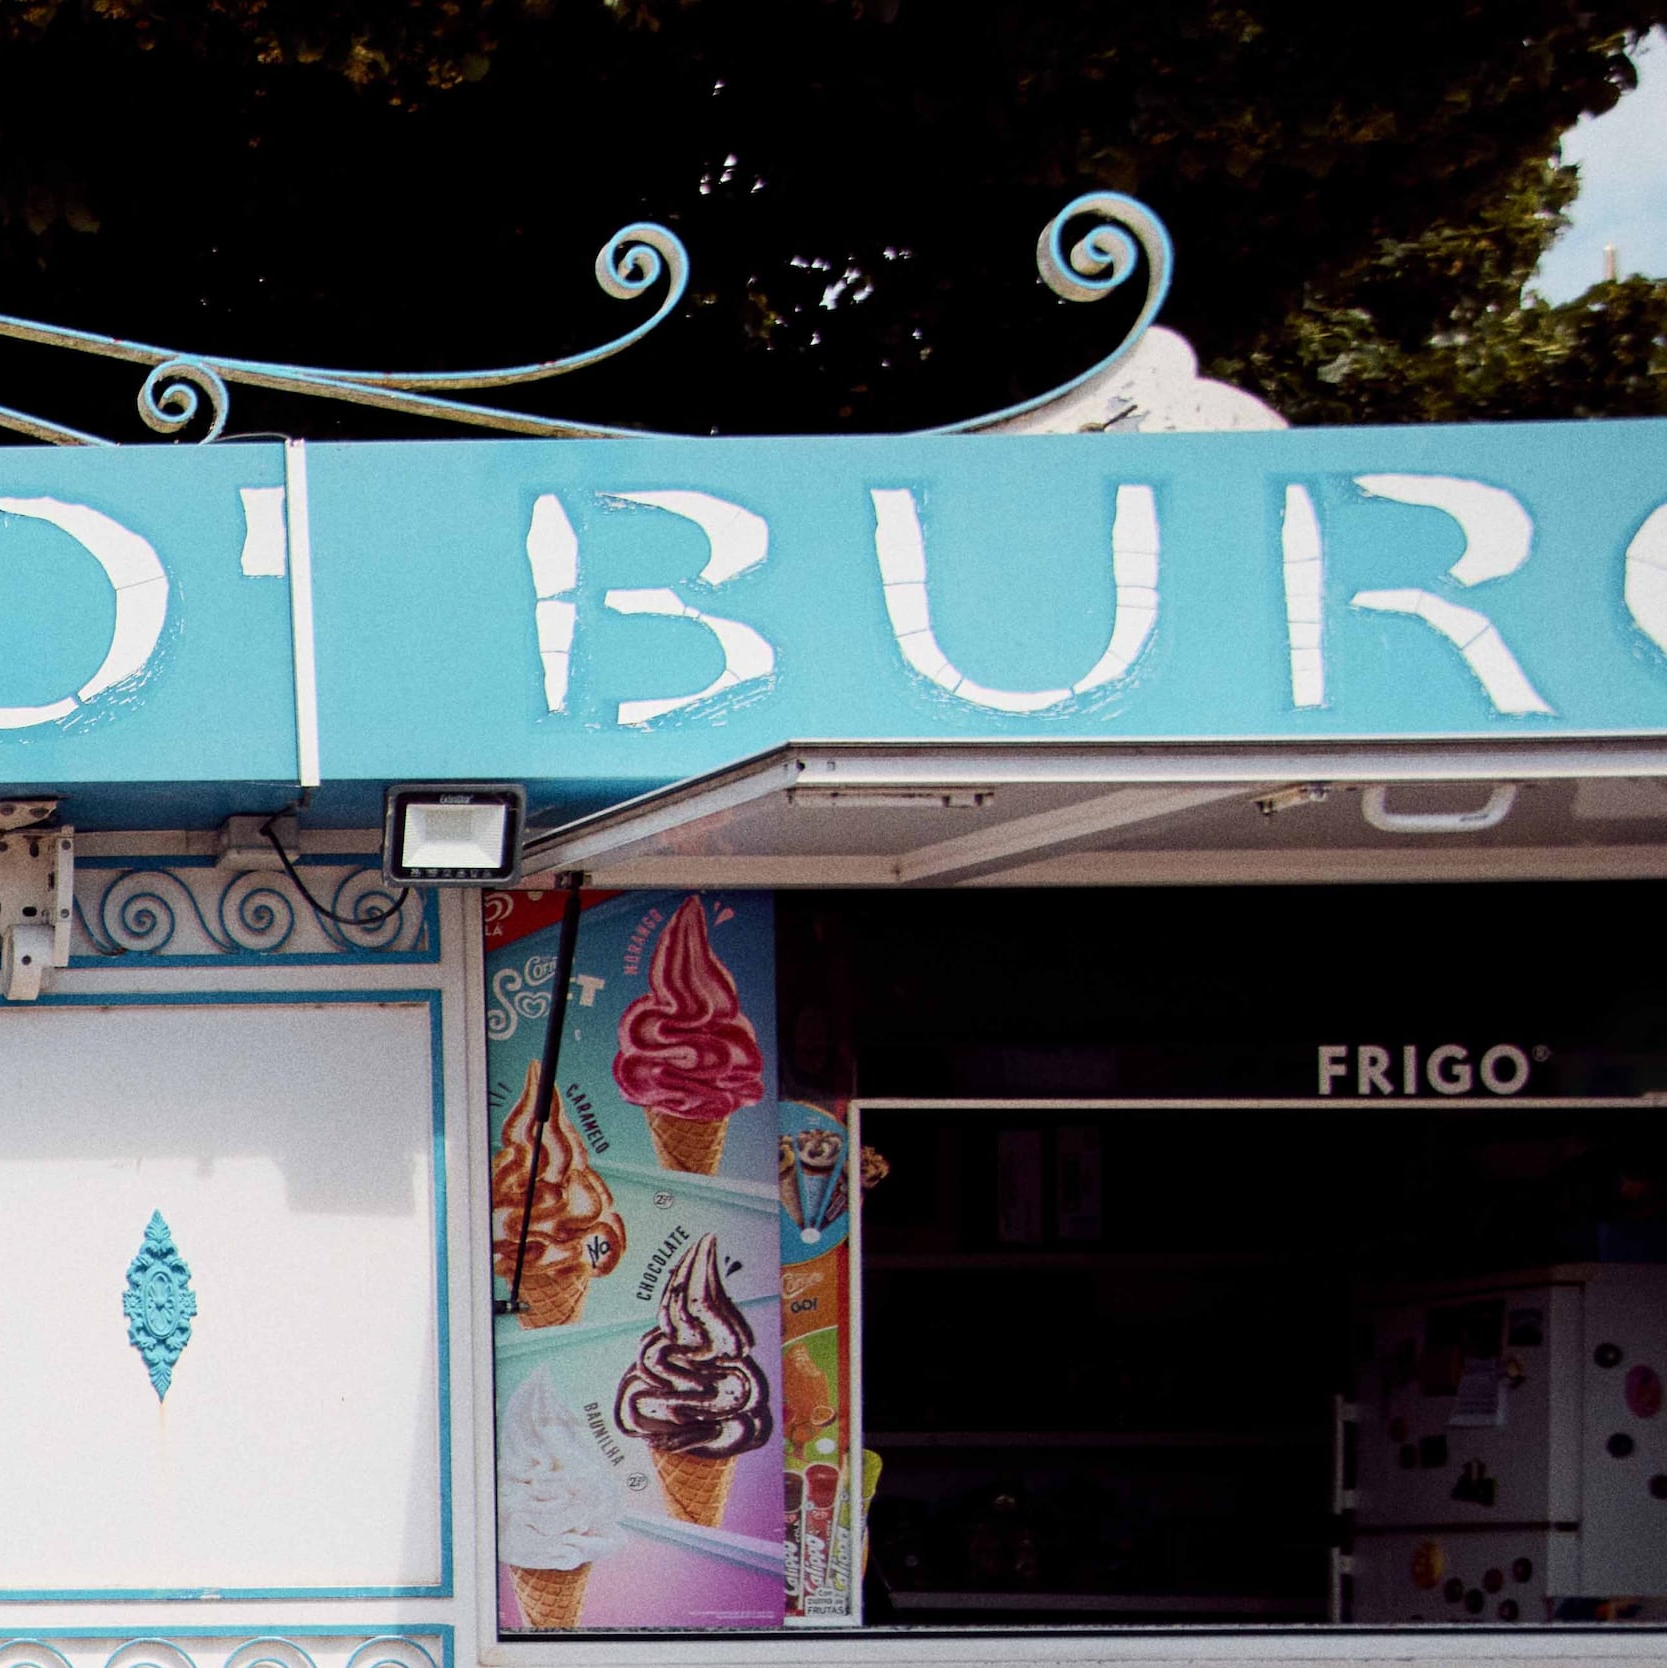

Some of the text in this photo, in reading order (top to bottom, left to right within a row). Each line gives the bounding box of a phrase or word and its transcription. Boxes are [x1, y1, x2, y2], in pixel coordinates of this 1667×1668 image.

[527, 473, 1667, 726] BUR
[623, 908, 664, 975] MORANGO
[566, 1083, 610, 1154] CARAMELO
[636, 1225, 690, 1301] CHOCOLATE
[584, 1402, 625, 1467] BAUNILHA
